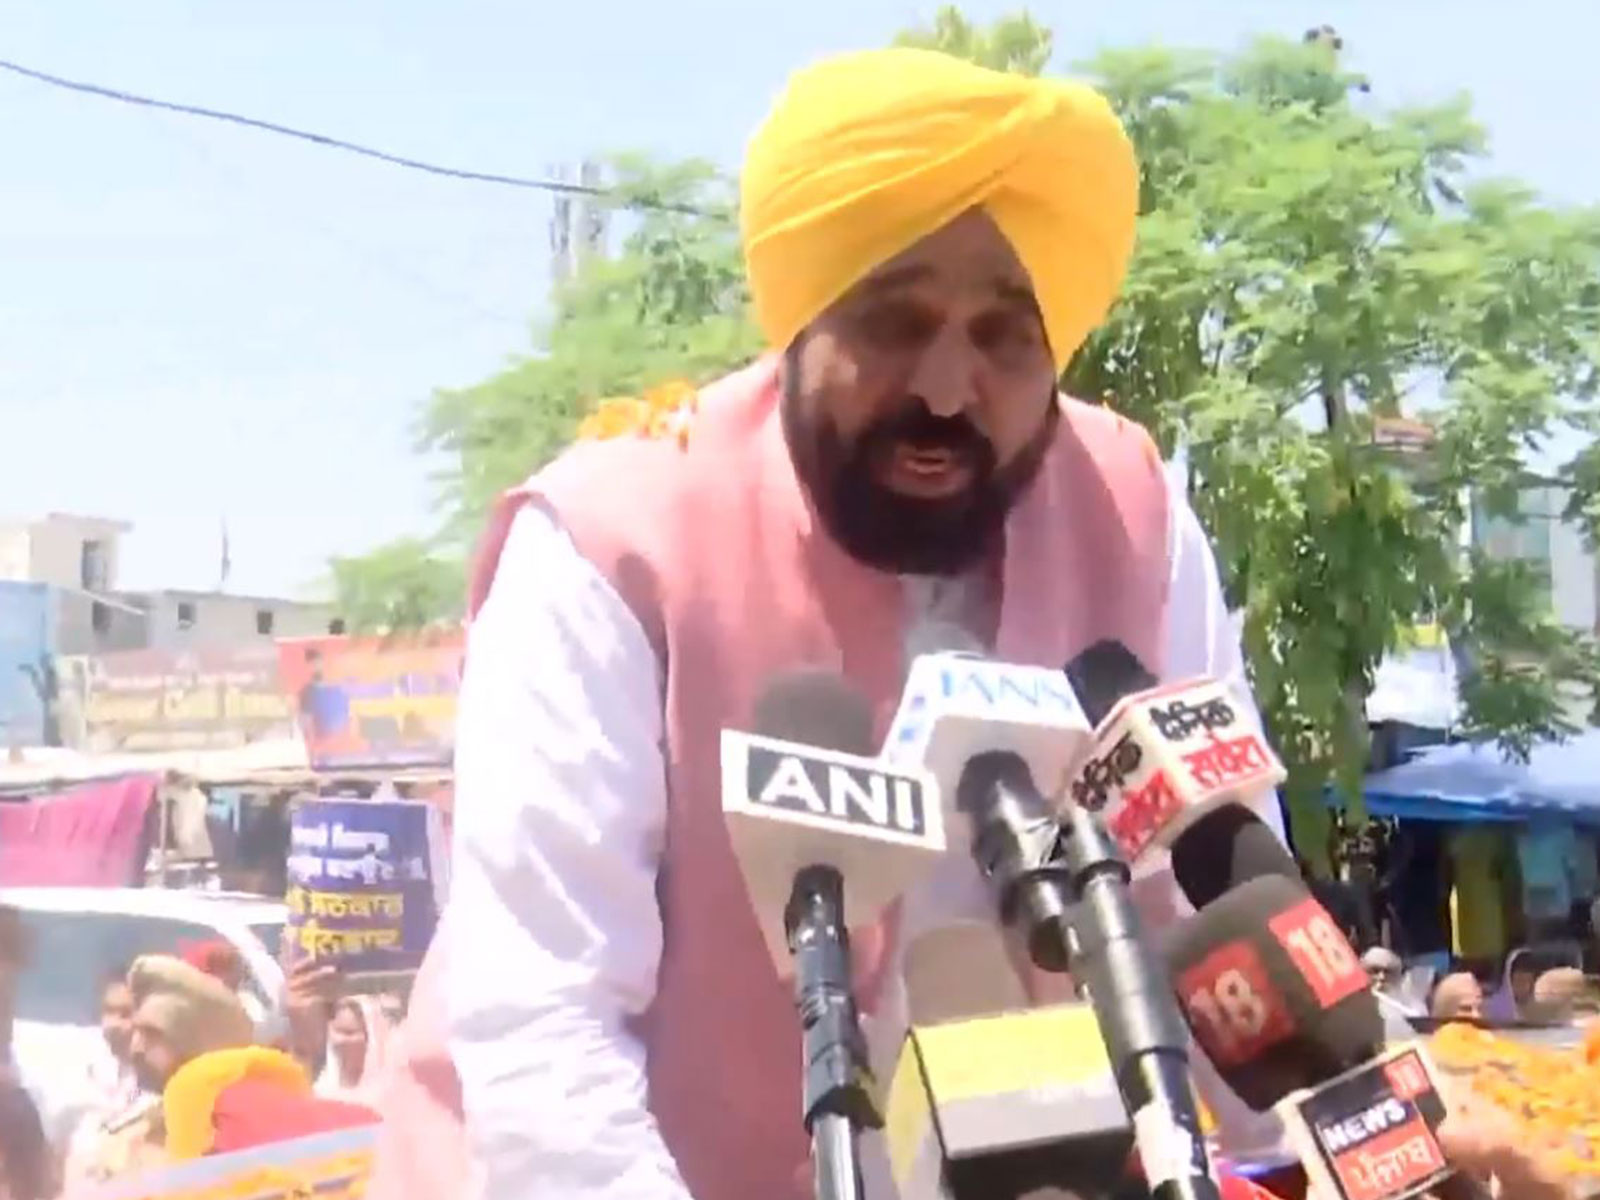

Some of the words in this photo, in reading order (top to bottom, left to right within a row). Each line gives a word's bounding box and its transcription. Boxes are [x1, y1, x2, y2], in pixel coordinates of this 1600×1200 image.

[759, 756, 917, 831] ANI
[1288, 915, 1354, 987] 18
[1189, 968, 1268, 1050] 18
[1322, 1097, 1407, 1152] NEWS
